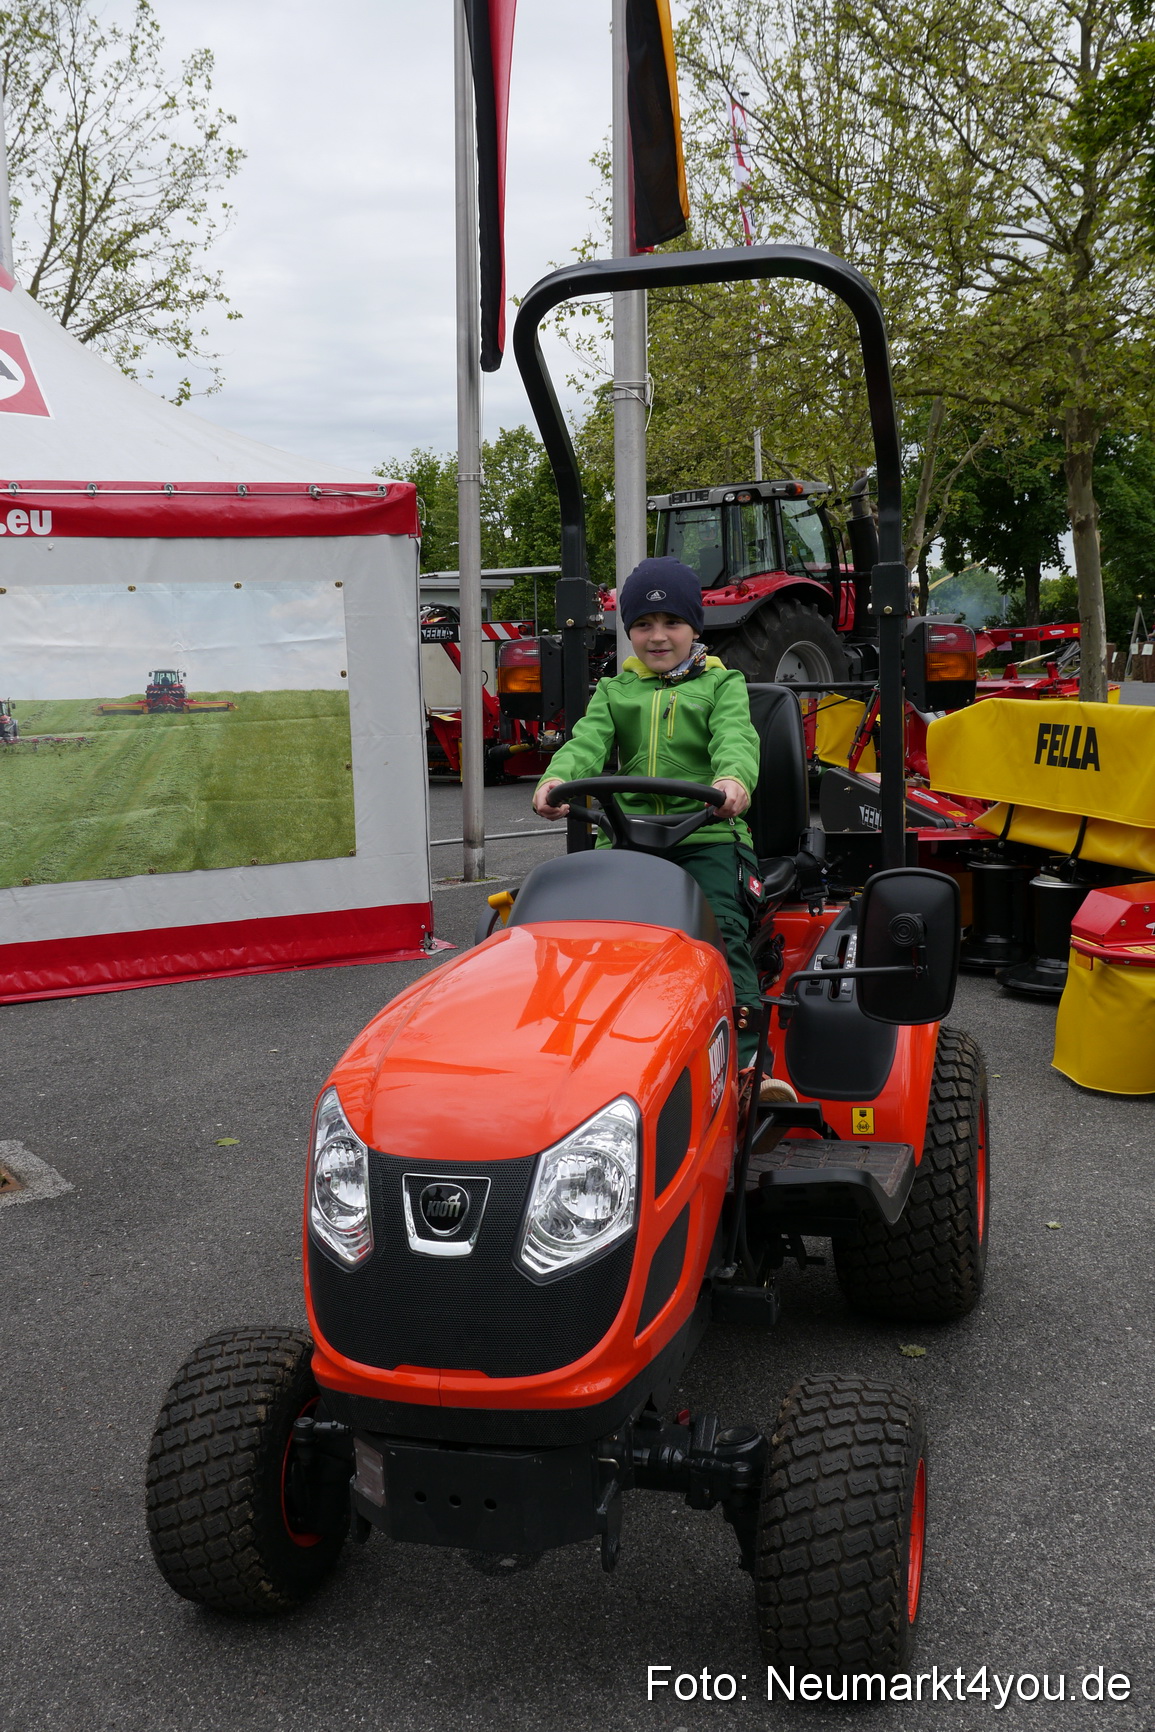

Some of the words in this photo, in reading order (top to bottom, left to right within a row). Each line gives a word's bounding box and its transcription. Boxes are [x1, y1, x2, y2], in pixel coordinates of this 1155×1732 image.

[425, 627, 452, 639] FELLA
[1034, 723, 1100, 771] FELLA
[427, 1200, 461, 1217] KIOTI
